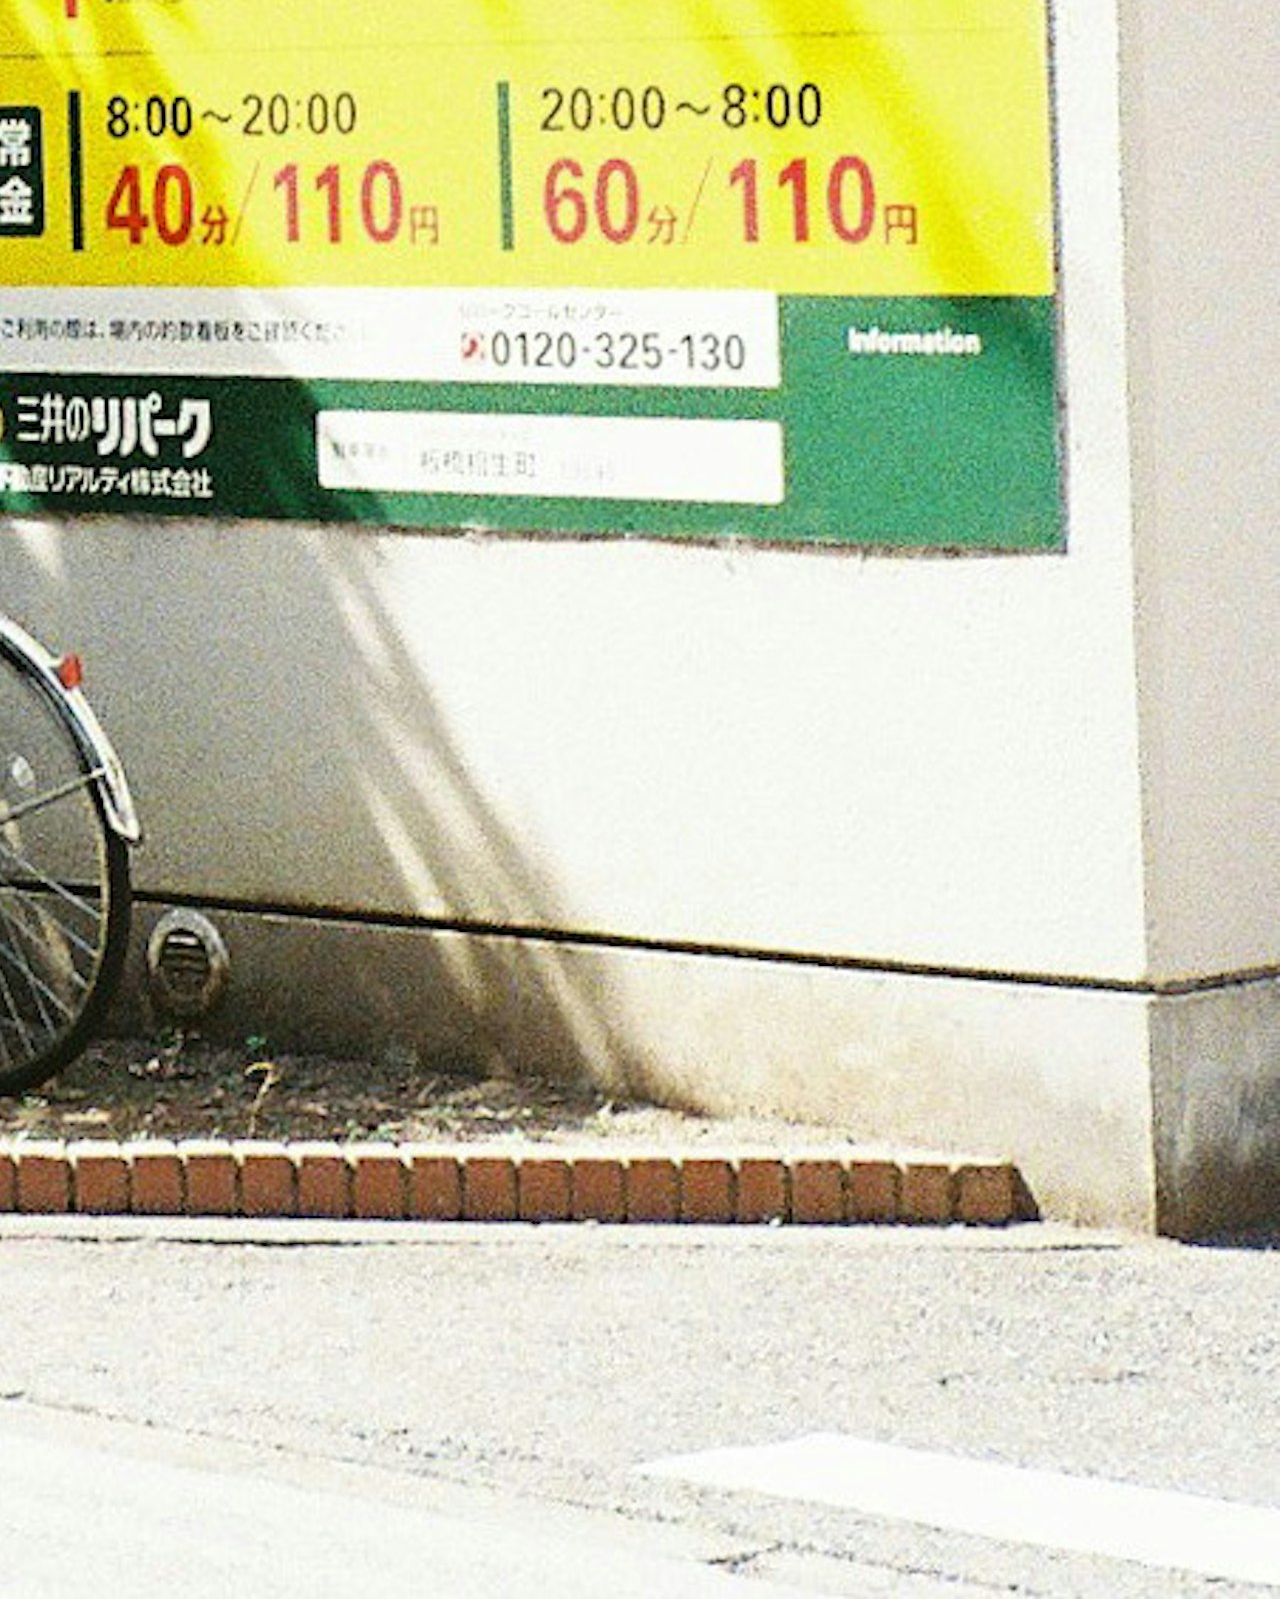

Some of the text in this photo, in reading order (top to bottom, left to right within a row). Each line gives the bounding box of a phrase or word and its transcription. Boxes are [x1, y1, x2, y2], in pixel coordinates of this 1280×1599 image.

[491, 331, 746, 371] 0120-325-130
[847, 325, 983, 357] Information
[15, 389, 213, 459] 三井のリパーク
